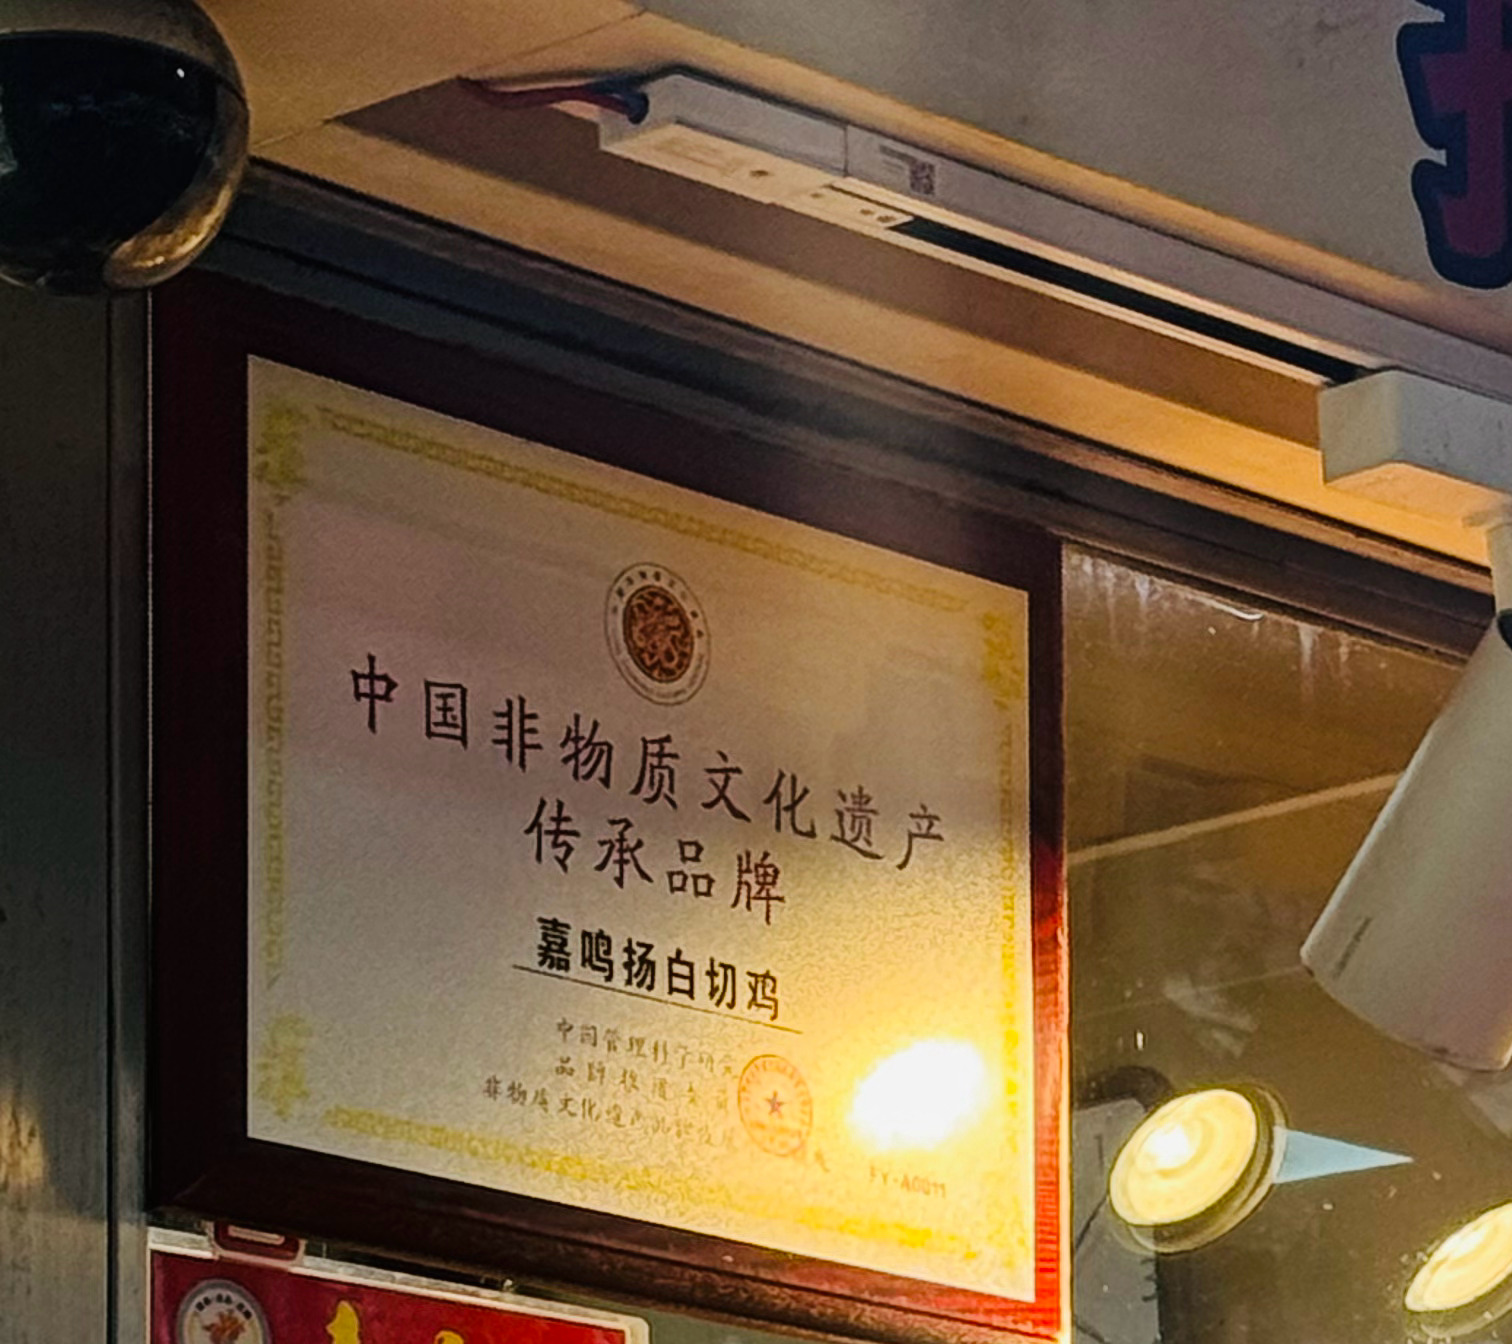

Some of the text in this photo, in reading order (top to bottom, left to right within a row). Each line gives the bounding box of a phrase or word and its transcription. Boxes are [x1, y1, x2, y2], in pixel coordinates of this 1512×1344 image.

[350, 653, 945, 870] 中国非物质文化遗产
[523, 796, 786, 926] 传承品牌
[536, 916, 779, 1022] 嘉鸣扬白切鸡
